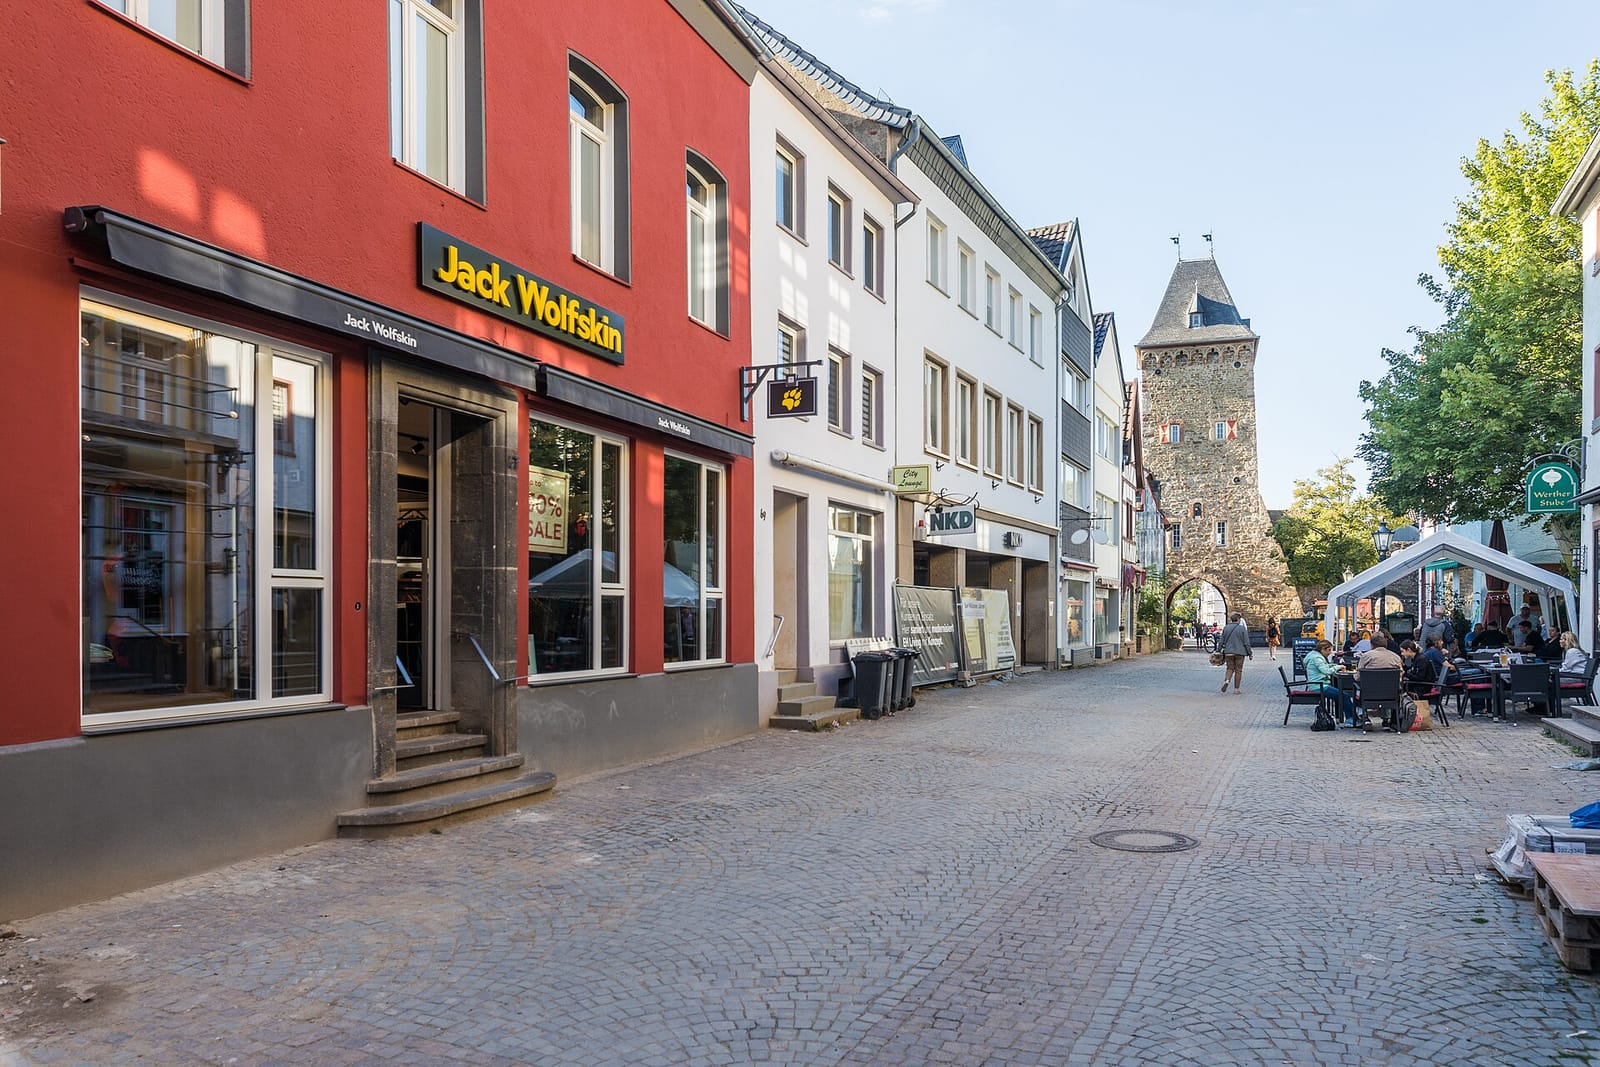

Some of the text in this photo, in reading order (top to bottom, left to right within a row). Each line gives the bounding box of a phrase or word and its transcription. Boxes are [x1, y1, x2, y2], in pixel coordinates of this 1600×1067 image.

[437, 245, 622, 354] Jack Wolfskin
[344, 313, 417, 348] Jack Wolfskin
[658, 417, 690, 435] Jack Wolfskin
[903, 469, 918, 479] City
[898, 479, 923, 488] Lounge
[1533, 490, 1571, 498] Werther
[1540, 499, 1565, 507] Stube
[760, 507, 767, 521] 69
[930, 510, 973, 531] NKD
